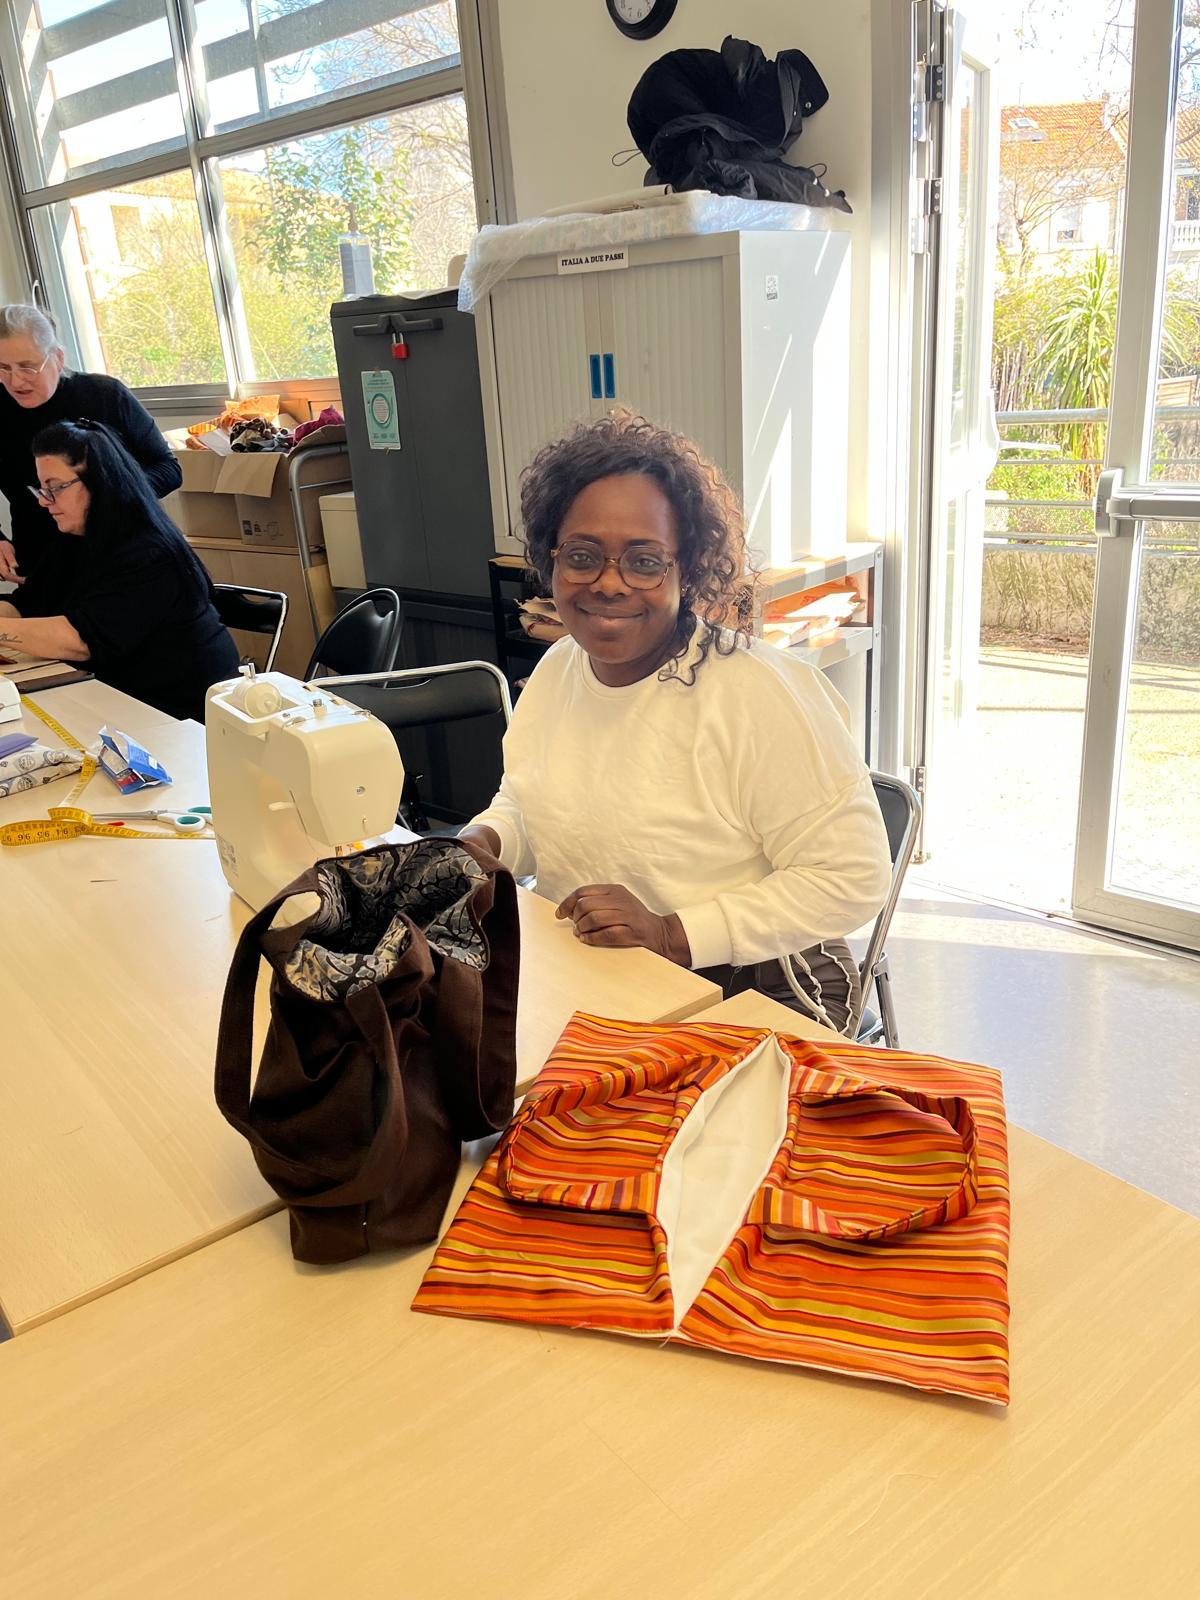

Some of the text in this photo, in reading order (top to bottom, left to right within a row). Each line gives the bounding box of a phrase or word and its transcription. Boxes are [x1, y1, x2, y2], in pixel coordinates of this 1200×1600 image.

[562, 258, 584, 266] ITALIA
[590, 255, 604, 263] DUE
[605, 253, 624, 262] PASSI
[17, 833, 31, 841] 96
[37, 830, 50, 839] 95
